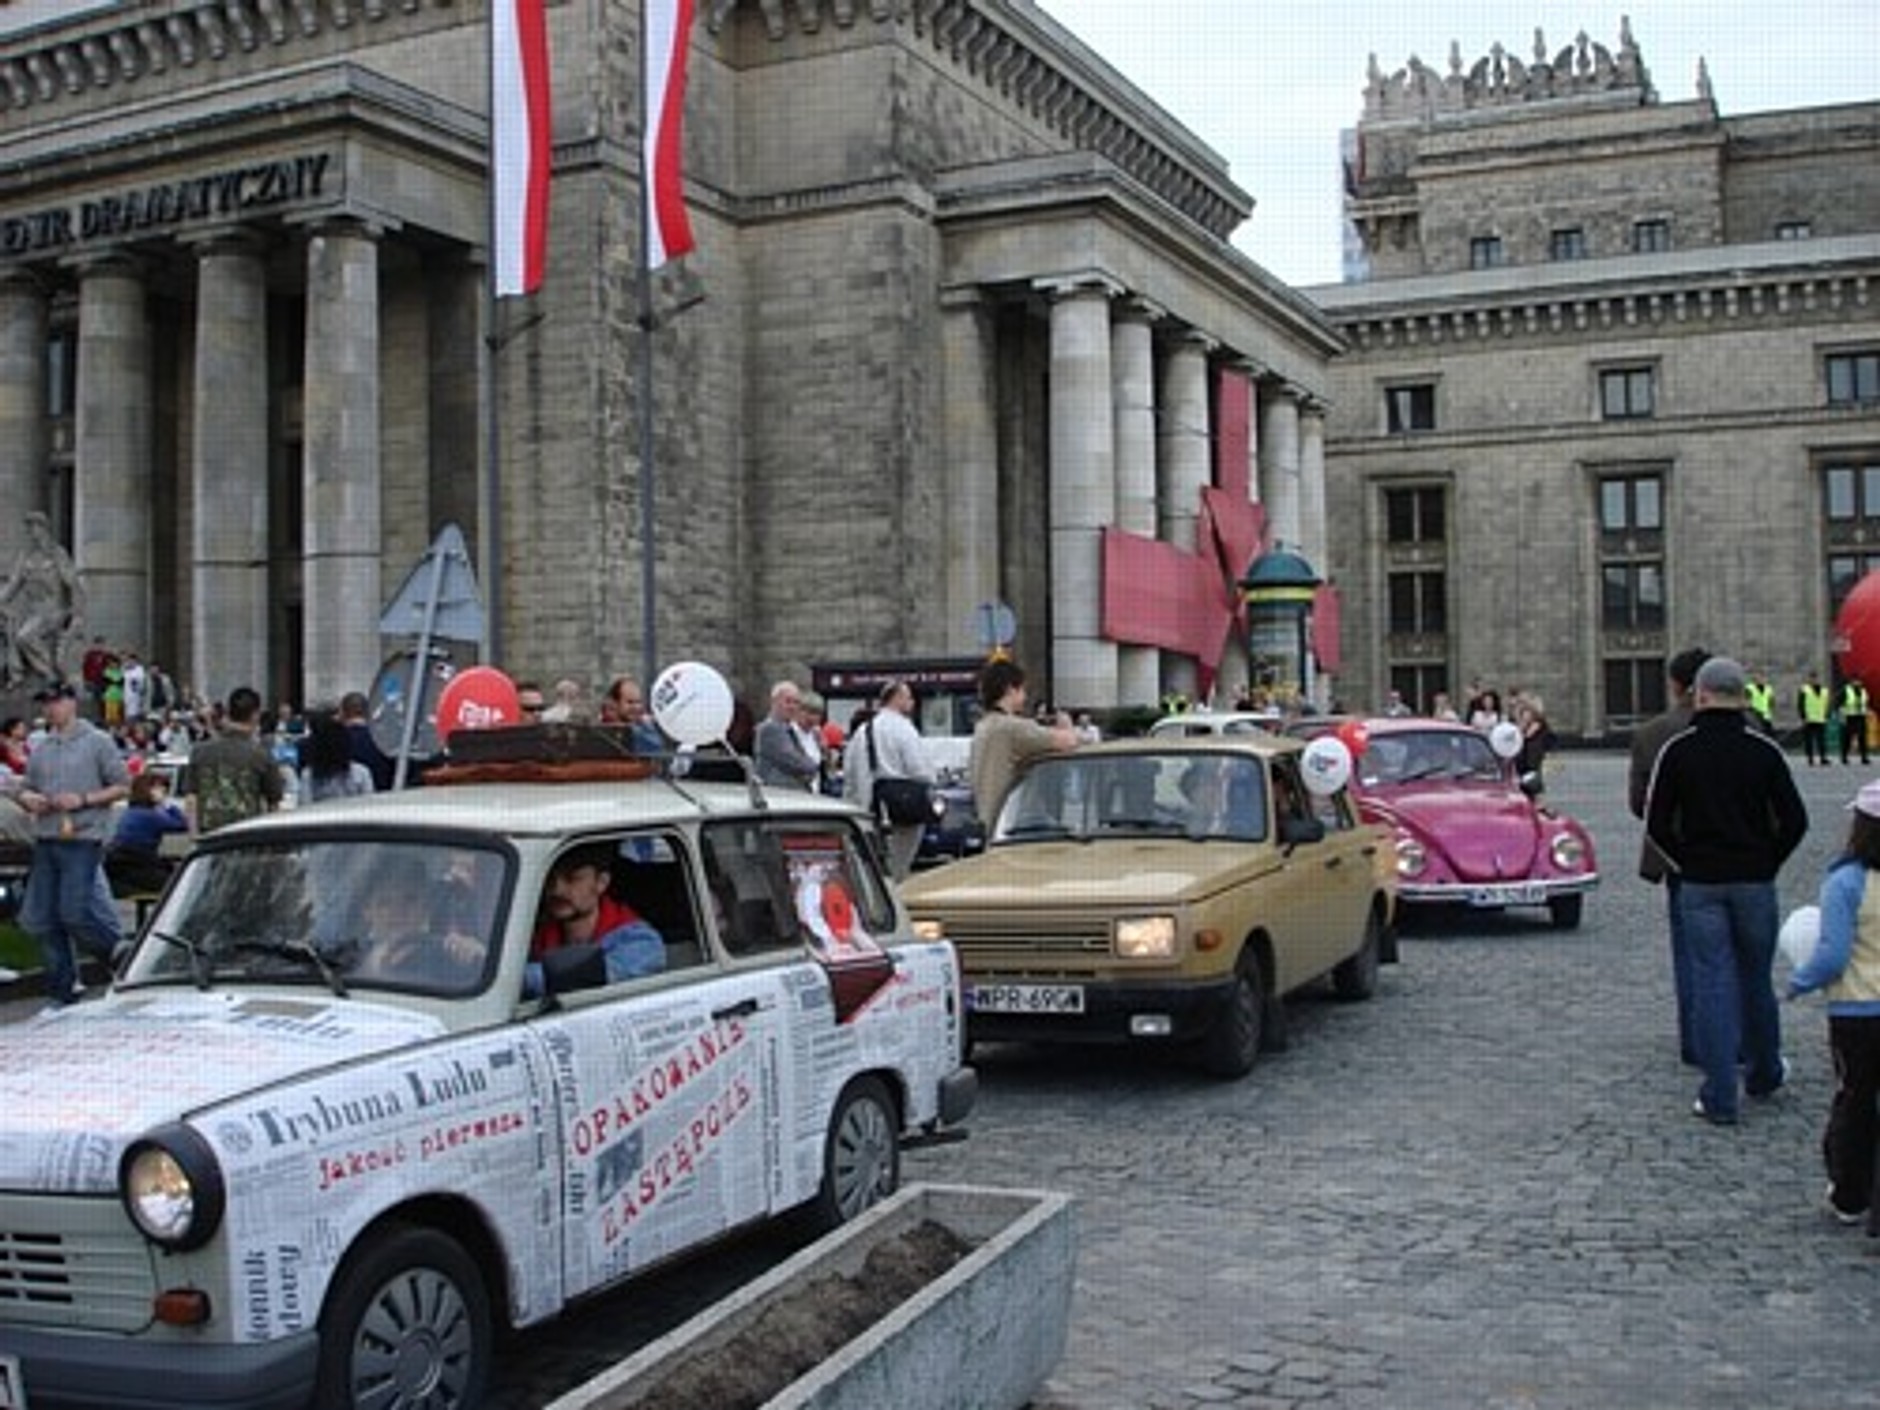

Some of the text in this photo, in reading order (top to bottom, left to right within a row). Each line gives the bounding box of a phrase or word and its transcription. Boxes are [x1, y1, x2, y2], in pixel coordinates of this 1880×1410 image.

[249, 1060, 487, 1145] Trybuna Ludu
[573, 1018, 746, 1156] OPAKOWANIE
